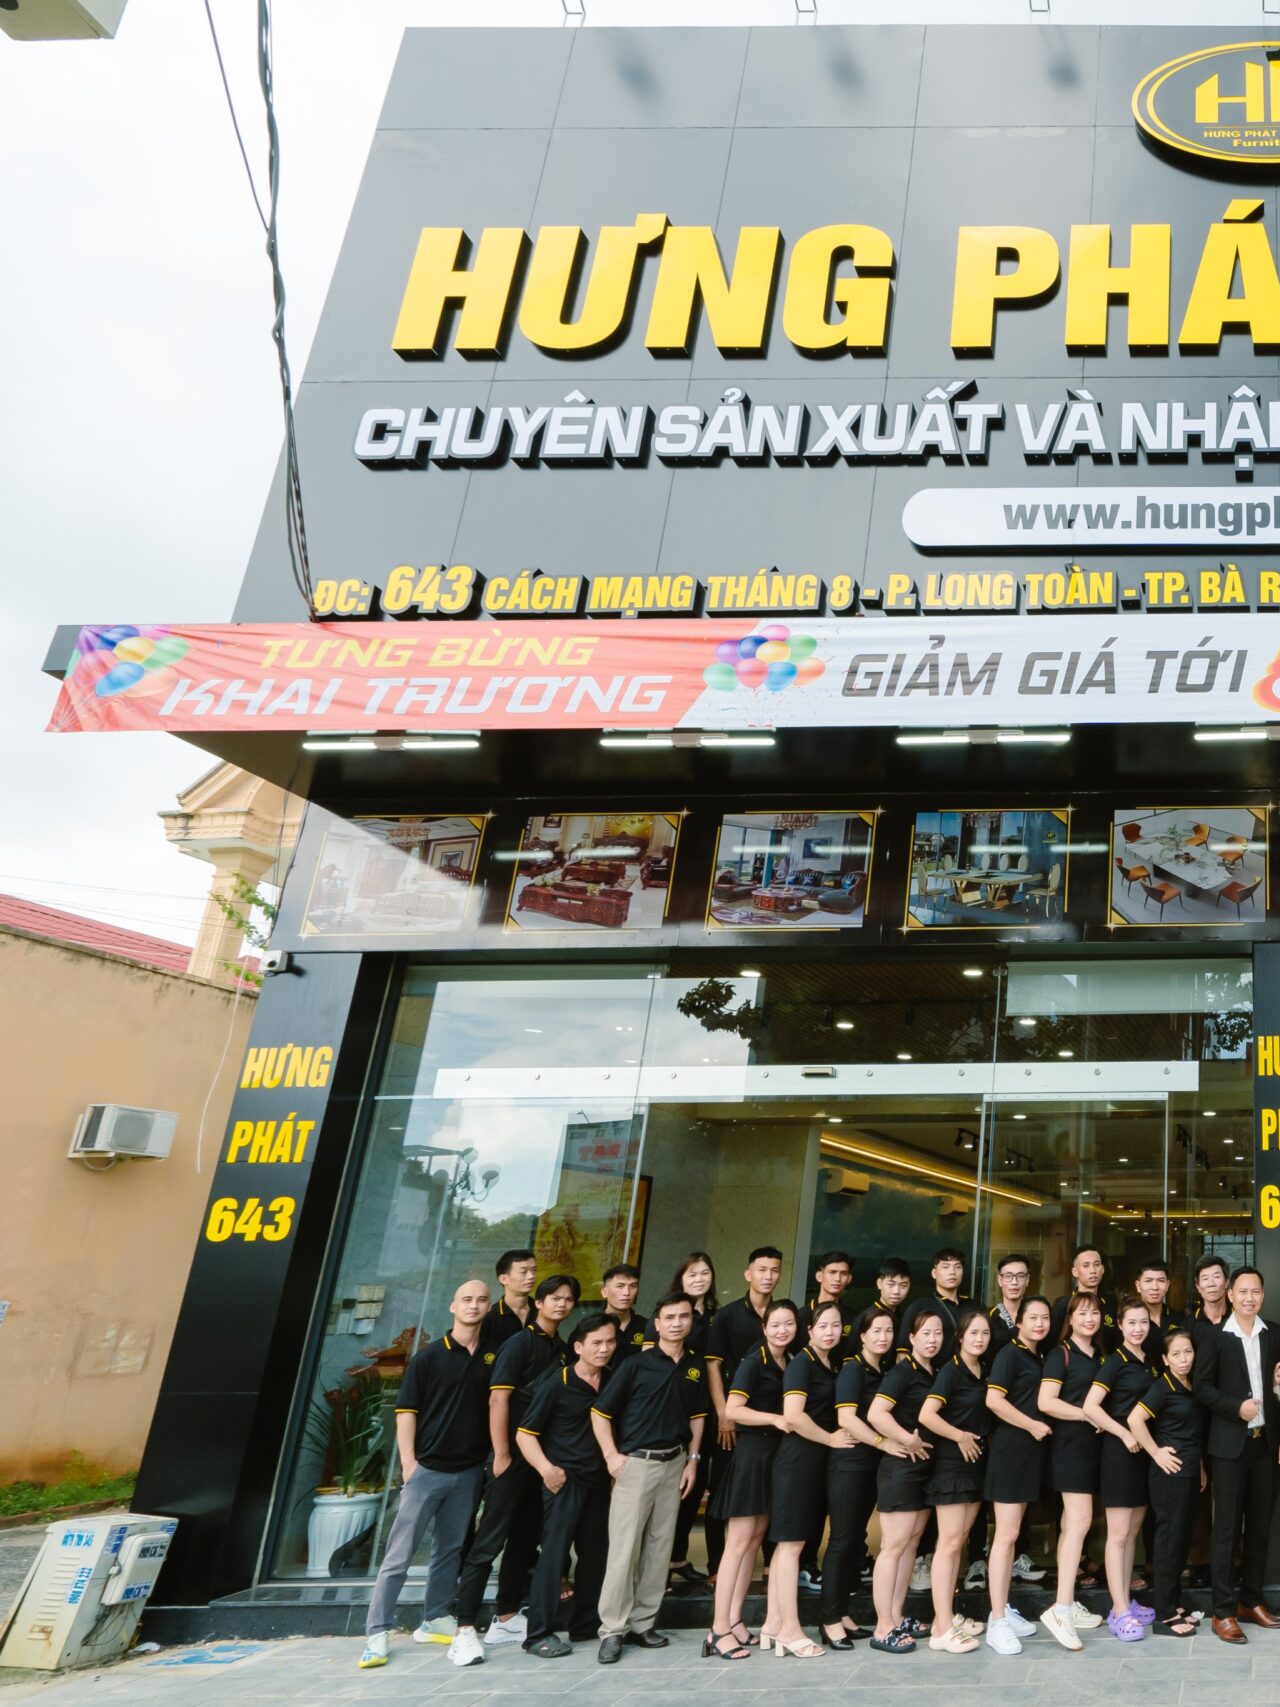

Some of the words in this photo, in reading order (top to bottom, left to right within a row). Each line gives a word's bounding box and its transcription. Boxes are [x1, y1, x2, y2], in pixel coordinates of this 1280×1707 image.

[1203, 130, 1241, 138] HƯNG
[392, 213, 895, 355] HƯNG
[354, 391, 648, 463] CHUYÊN
[654, 388, 805, 461] SẢN
[816, 382, 1000, 460] XUẤT
[1015, 389, 1107, 457] VÀ
[313, 579, 369, 614] ĐC:
[381, 565, 475, 613] 643
[485, 569, 577, 612] CÁCH
[587, 574, 692, 617] MẠNG
[707, 569, 817, 610] THÁNG
[830, 573, 851, 609] 8
[885, 573, 913, 608] P.
[923, 572, 1013, 609] LONG
[1025, 565, 1115, 607] TOÀN
[1144, 571, 1190, 606] TP.
[1200, 565, 1246, 605] BÀ
[259, 637, 413, 668] TƯNG
[428, 628, 600, 667] BỪNG
[841, 635, 1003, 698] GIẢM
[1017, 637, 1119, 696] GIÁ
[1144, 636, 1249, 694] TỚI
[158, 677, 345, 716] KHAI
[363, 675, 673, 715] TRƯƠNG
[240, 1043, 334, 1088] HƯNG
[226, 1112, 316, 1163] PHÁT
[205, 1196, 296, 1242] 643
